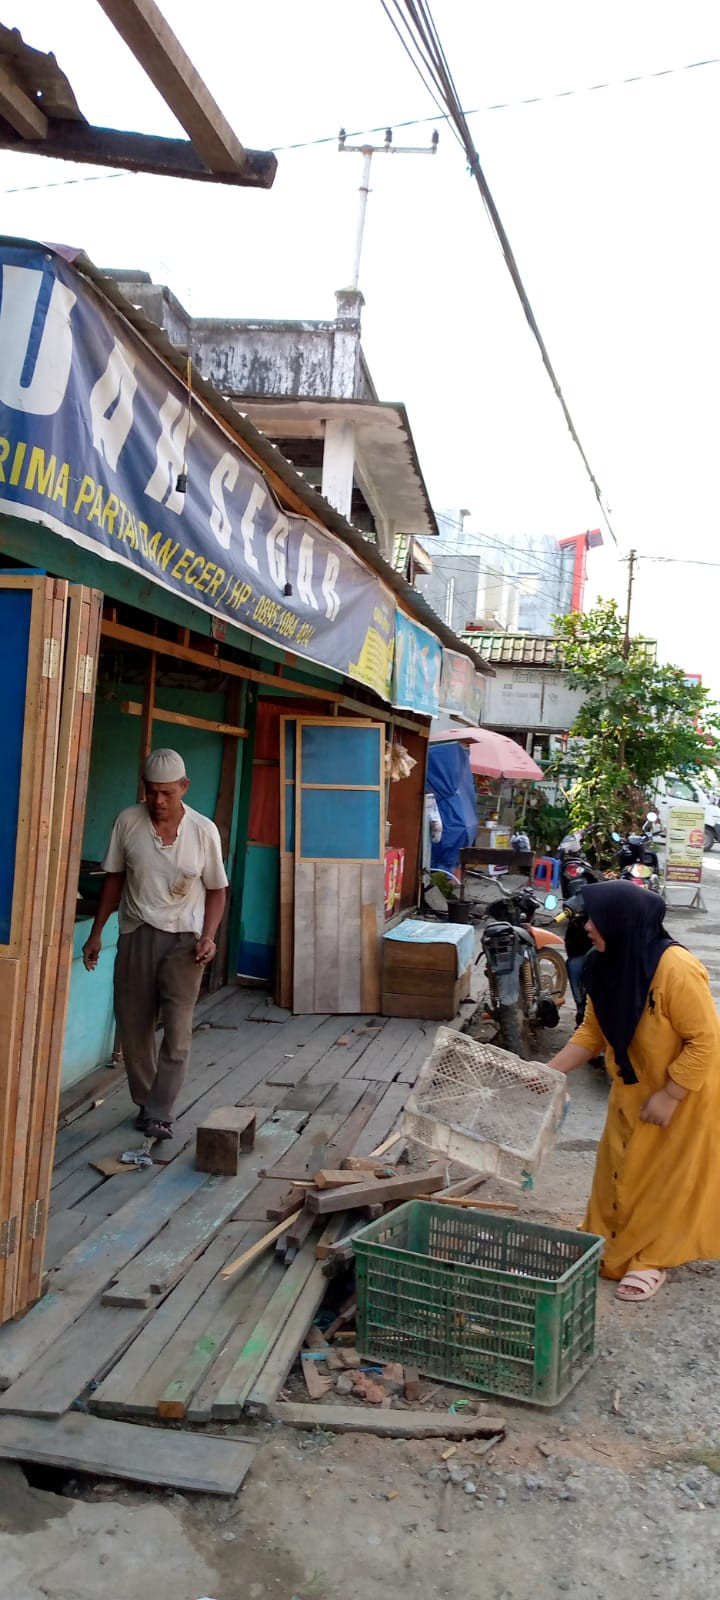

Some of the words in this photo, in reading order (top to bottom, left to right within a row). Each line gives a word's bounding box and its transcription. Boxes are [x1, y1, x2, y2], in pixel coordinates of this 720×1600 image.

[73, 475, 139, 550] PARTAI
[139, 521, 180, 571] DAN
[171, 548, 225, 597] ECER
[210, 452, 340, 622] SEGAR
